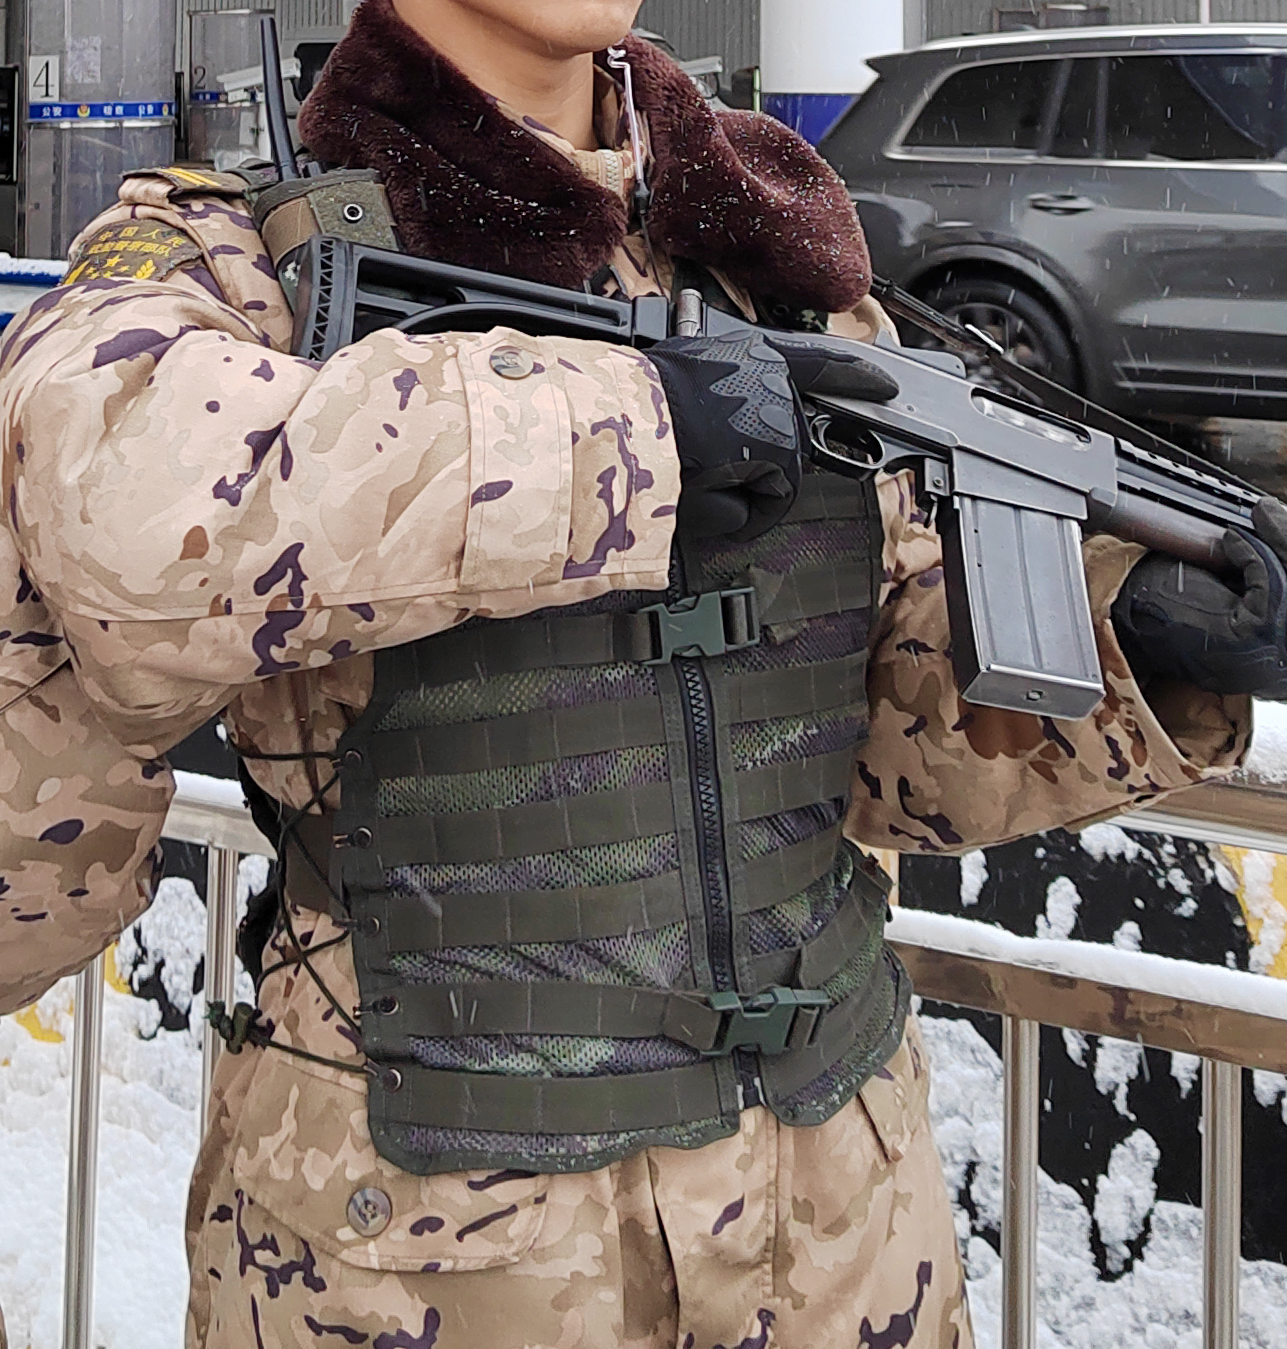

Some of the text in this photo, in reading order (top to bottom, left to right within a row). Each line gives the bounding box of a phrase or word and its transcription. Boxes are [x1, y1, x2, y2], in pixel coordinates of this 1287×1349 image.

[32, 59, 55, 98] 4
[194, 66, 206, 89] 2
[98, 226, 186, 248] 中国人民
